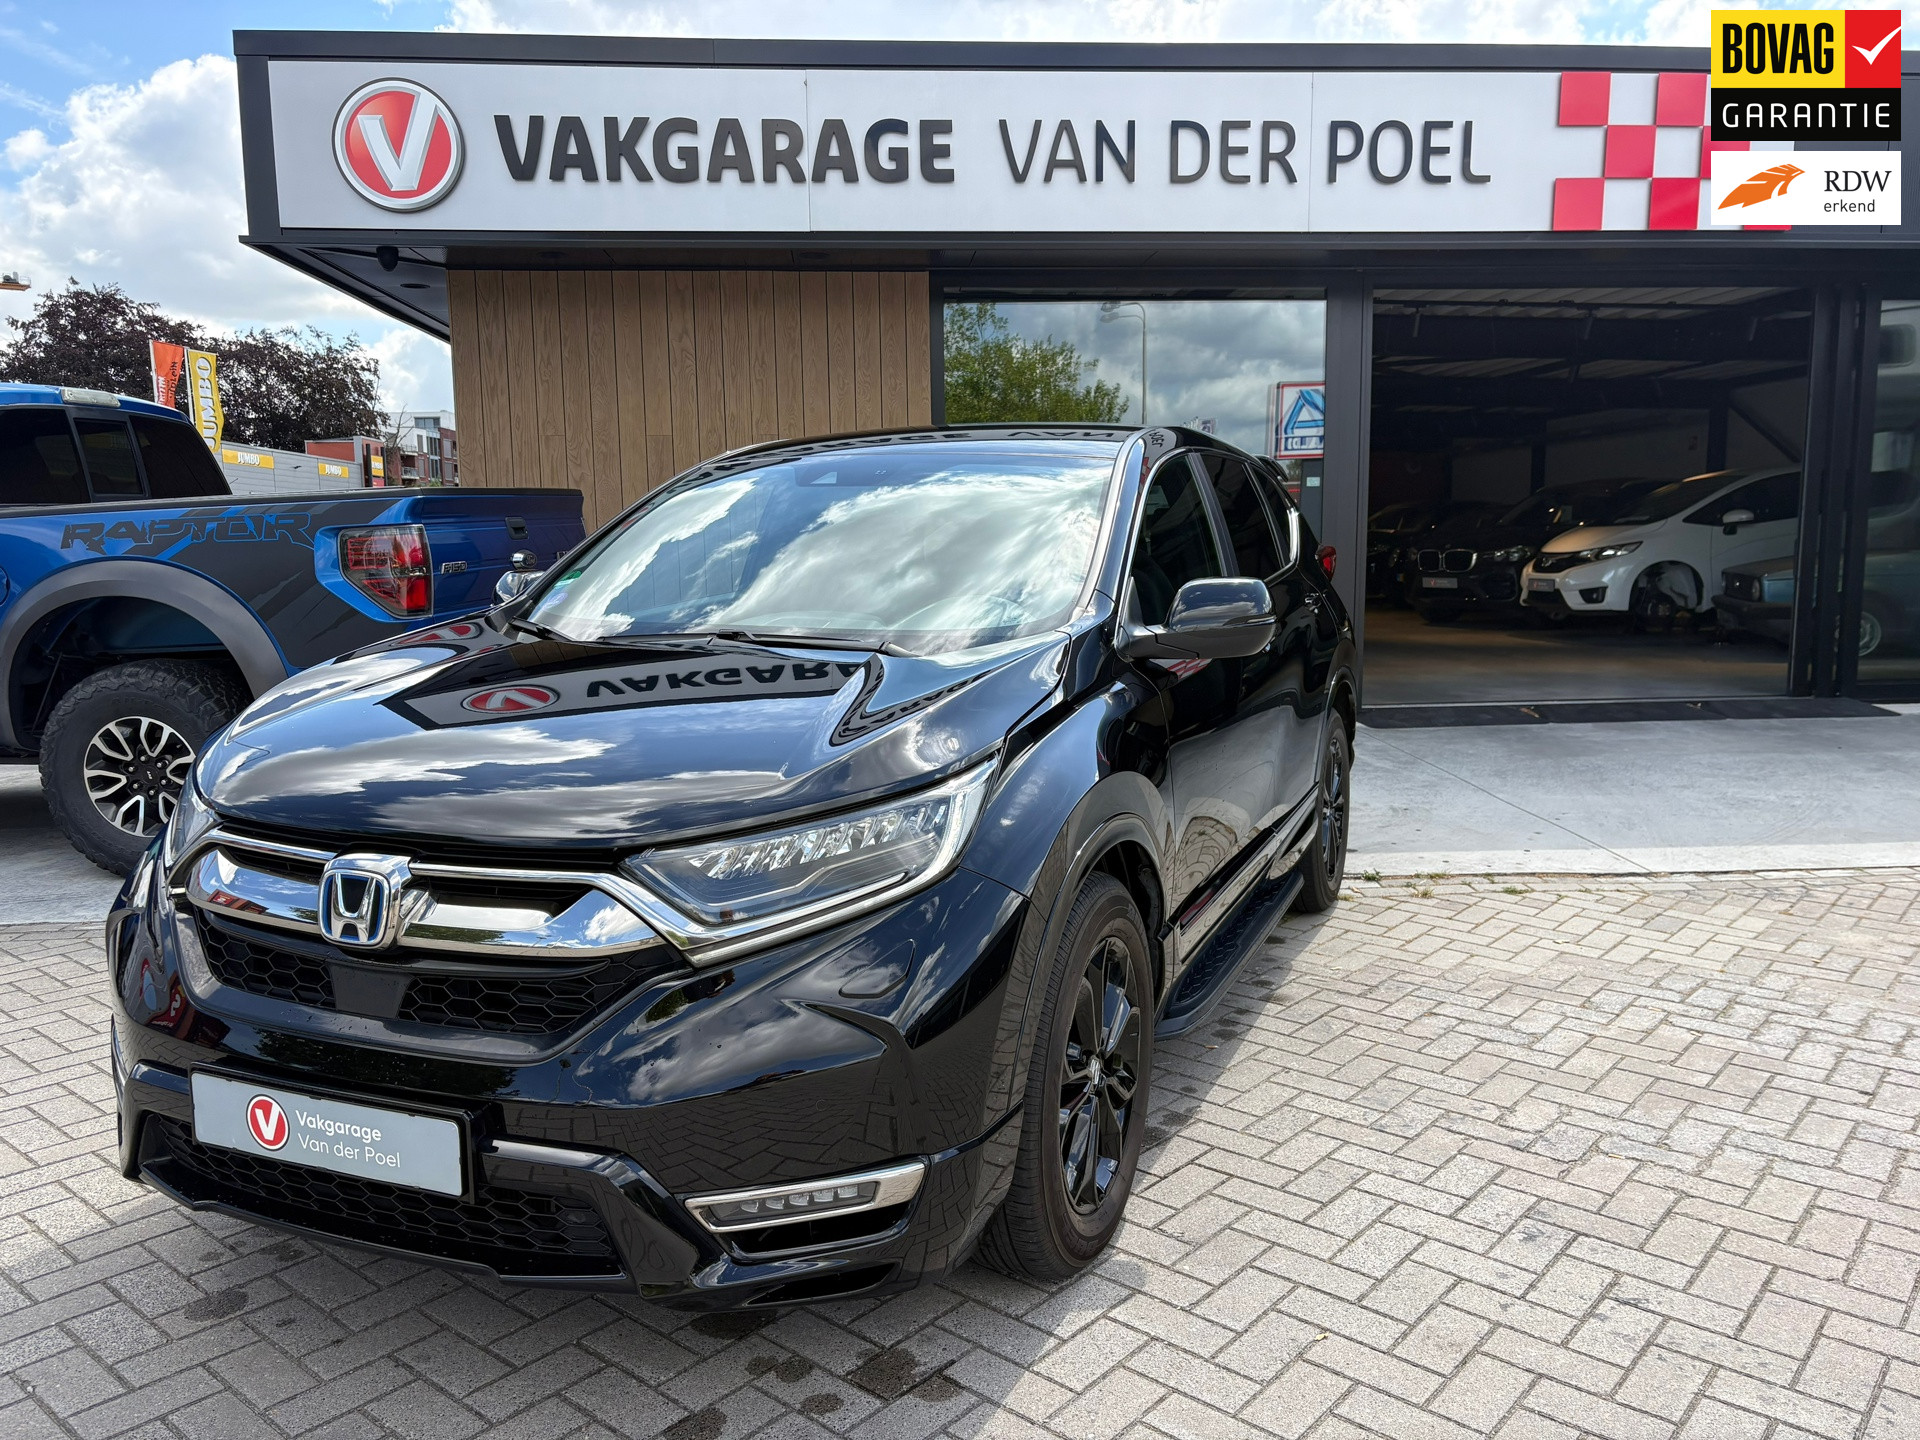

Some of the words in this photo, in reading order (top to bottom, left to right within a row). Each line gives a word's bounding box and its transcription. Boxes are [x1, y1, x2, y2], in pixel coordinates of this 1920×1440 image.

[493, 114, 955, 183] VAKGARAGE
[998, 118, 1136, 184] VAN
[1169, 119, 1298, 184] DER
[1327, 119, 1492, 184] POEL
[195, 356, 217, 450] JUMBO
[237, 451, 260, 466] JUMBO
[60, 512, 315, 553] RAPTOR
[295, 1109, 382, 1144] Vakgarage
[297, 1132, 330, 1154] Van
[333, 1141, 360, 1160] der
[364, 1146, 400, 1168] Poel
